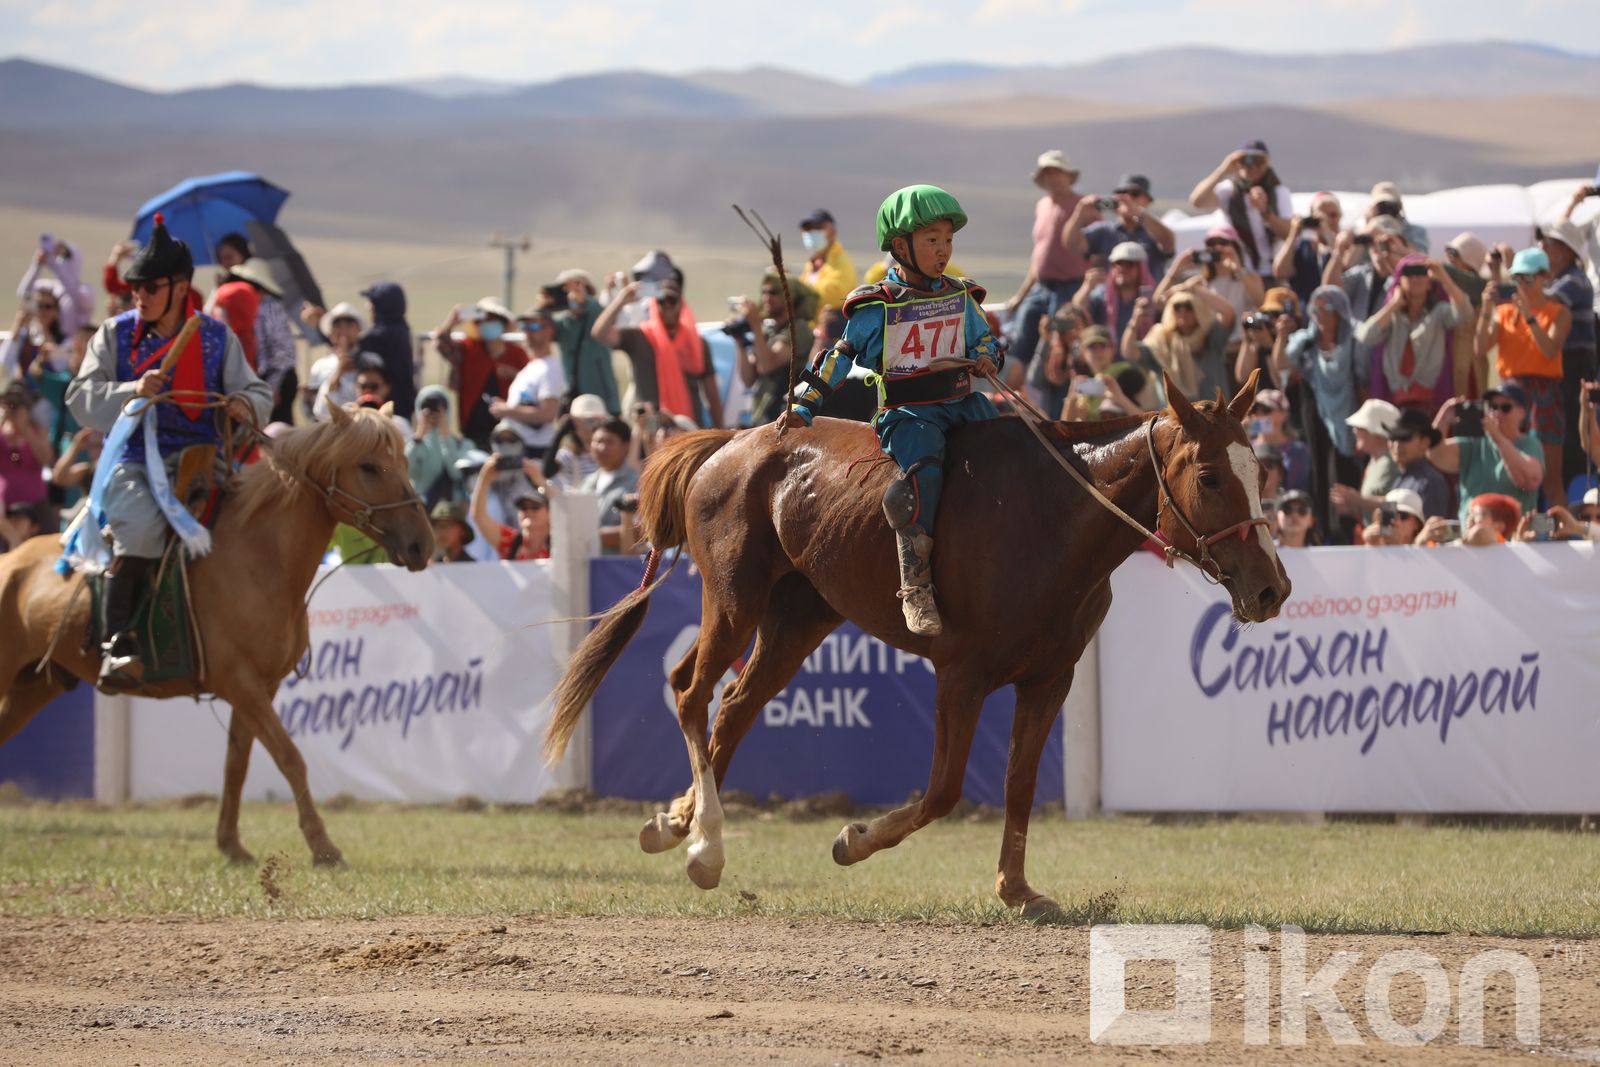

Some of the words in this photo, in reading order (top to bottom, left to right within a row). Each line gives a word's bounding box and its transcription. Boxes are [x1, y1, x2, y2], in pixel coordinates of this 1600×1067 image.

[901, 317, 961, 360] 477
[1285, 595, 1362, 619] соёлоо
[1366, 591, 1457, 619] дээдлэн
[1189, 601, 1388, 698] Сайхан
[763, 687, 872, 728] БАНК
[1266, 651, 1540, 755] наадаарай
